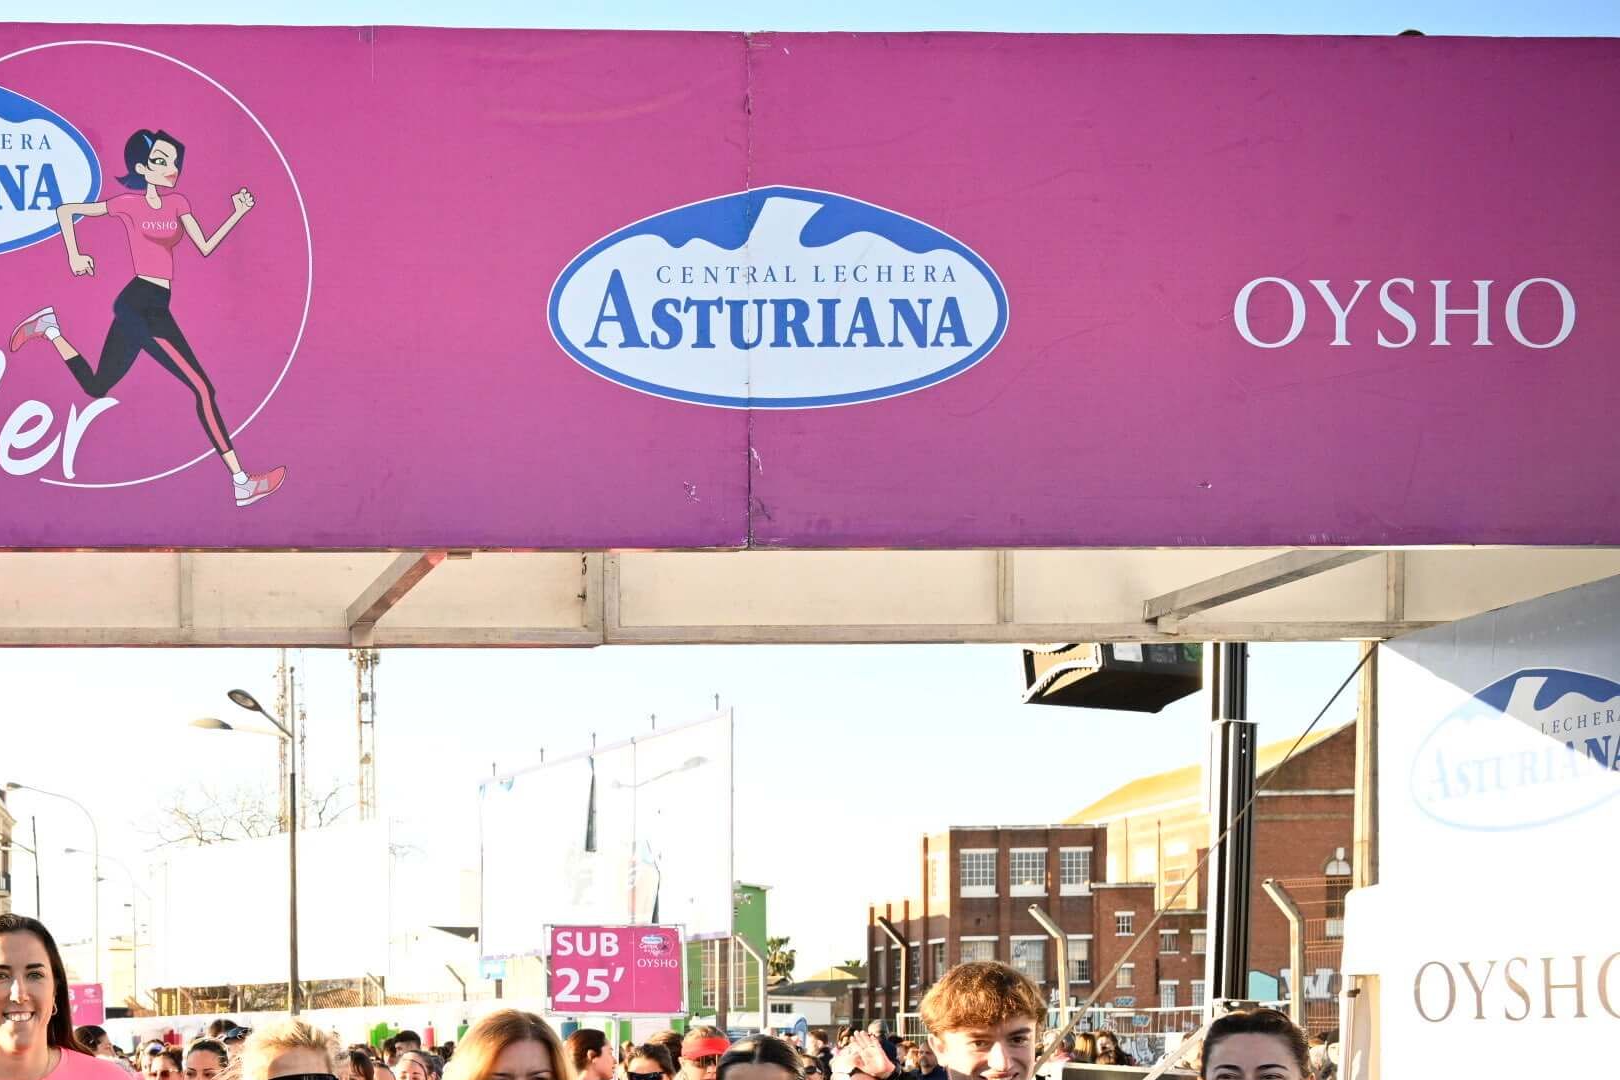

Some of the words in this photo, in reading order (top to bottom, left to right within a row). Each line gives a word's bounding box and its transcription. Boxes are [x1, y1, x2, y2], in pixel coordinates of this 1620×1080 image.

[142, 220, 178, 230] OYSHO
[655, 264, 797, 285] CENTRAL
[812, 263, 958, 286] LECHERA
[584, 268, 973, 351] ASTURIANA
[1233, 276, 1577, 349] OYSHO
[556, 931, 620, 958] SUB
[637, 958, 678, 969] OYSHO
